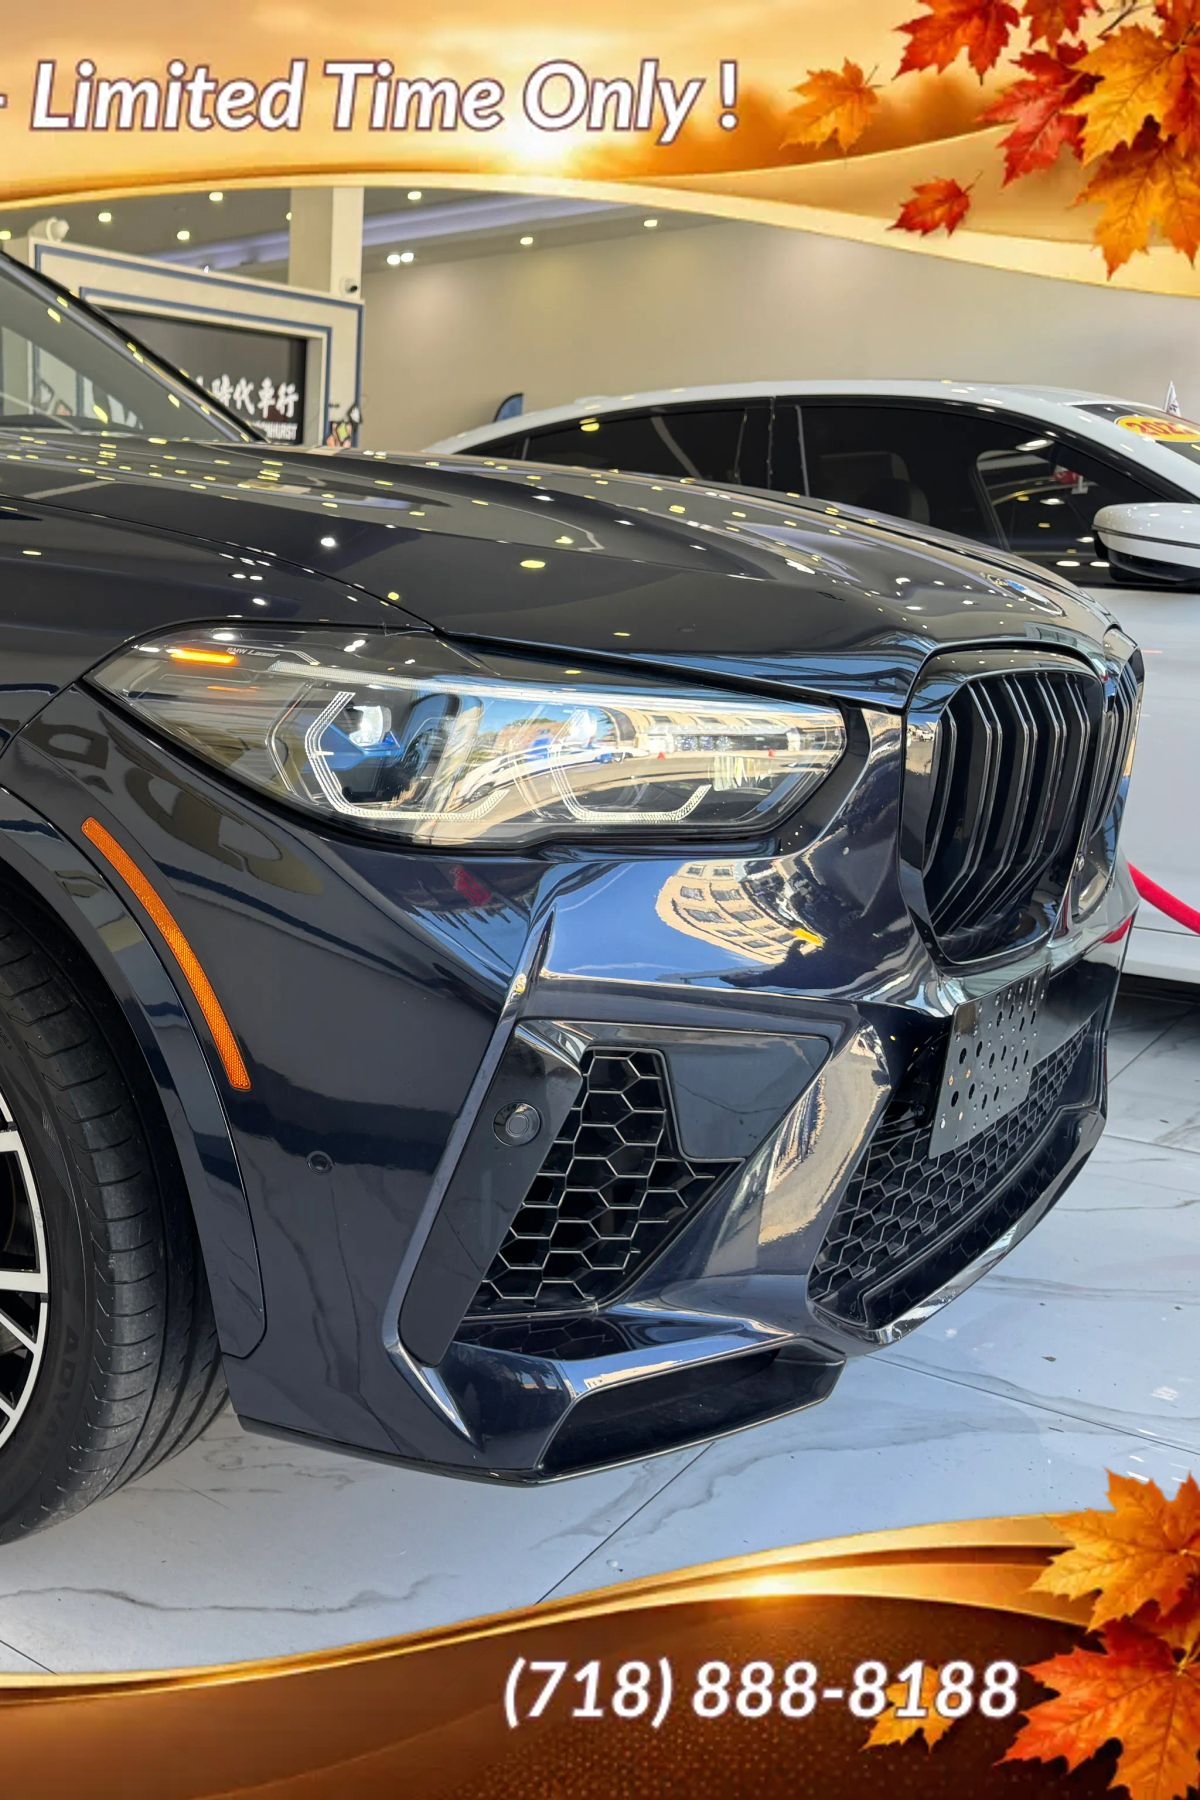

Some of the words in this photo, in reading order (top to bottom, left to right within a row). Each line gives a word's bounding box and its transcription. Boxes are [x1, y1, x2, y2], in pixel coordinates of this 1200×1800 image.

[195, 374, 299, 418] 時代車行
[1125, 420, 1195, 437] 202
